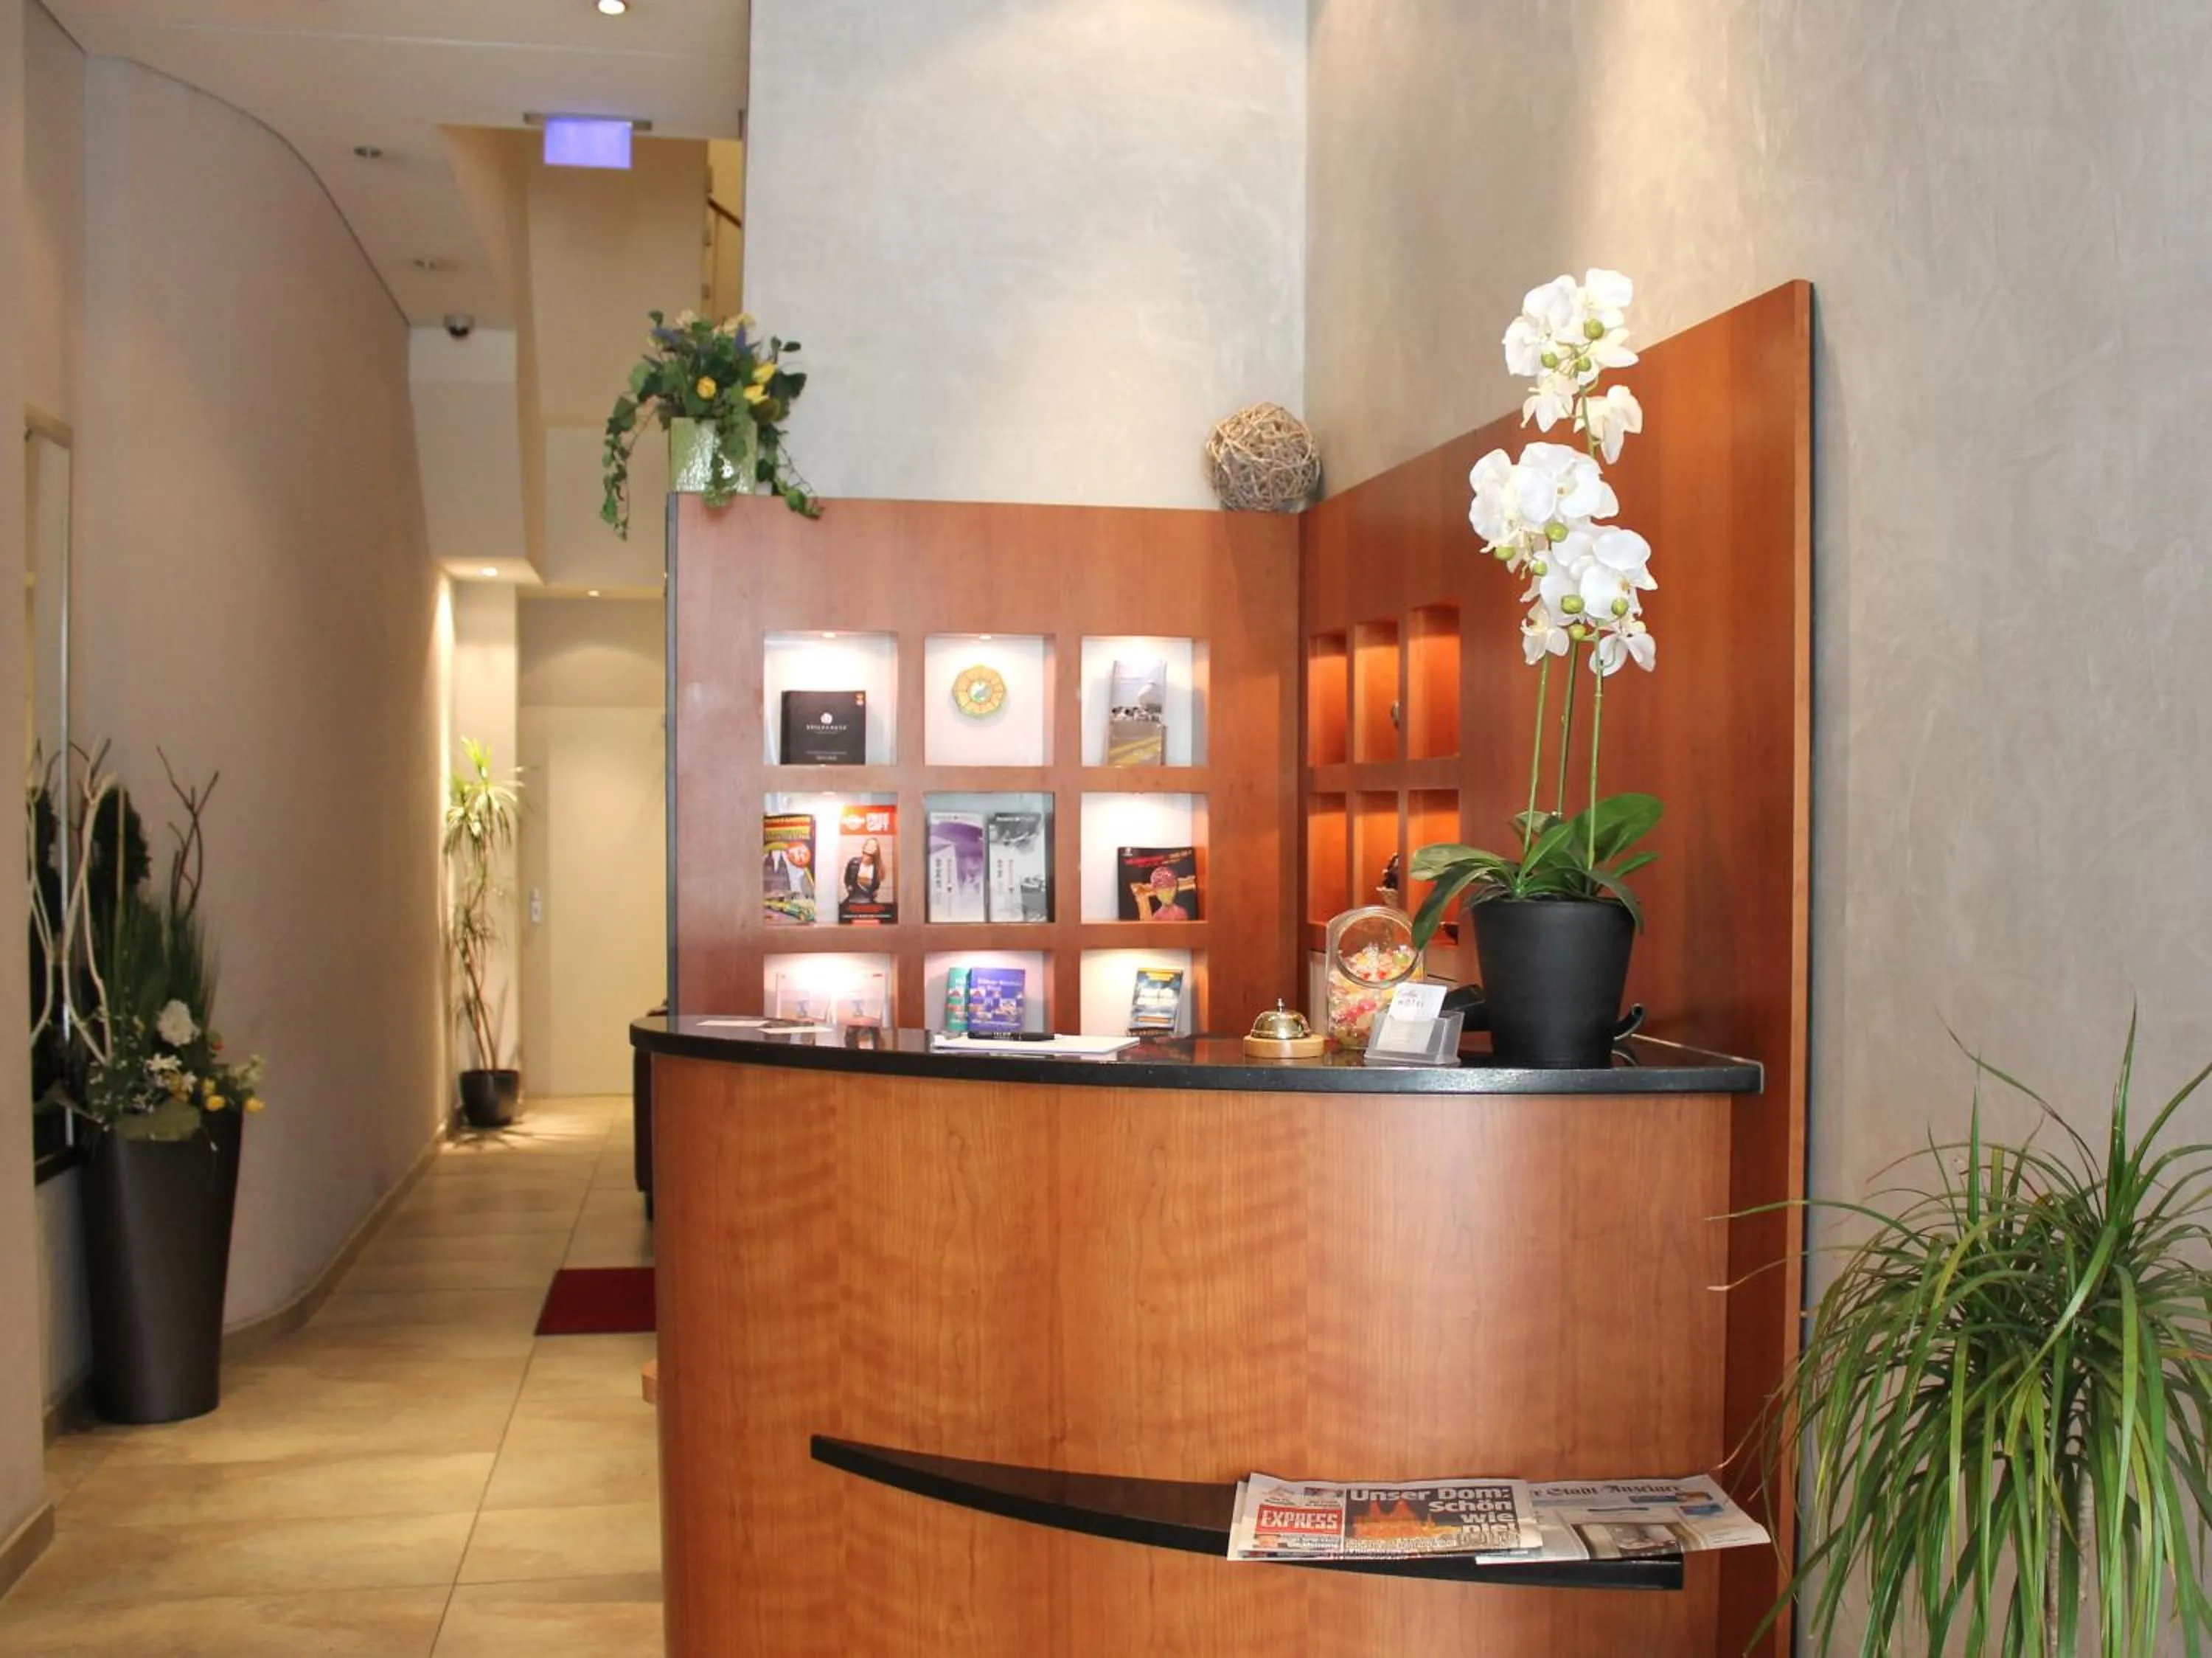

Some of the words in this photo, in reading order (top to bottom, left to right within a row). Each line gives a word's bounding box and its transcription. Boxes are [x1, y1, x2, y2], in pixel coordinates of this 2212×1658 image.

[1350, 1489, 1431, 1501] Unser
[1438, 1488, 1510, 1499] Dom:
[1260, 1509, 1338, 1530] EXPRESS
[1460, 1511, 1514, 1524] wie
